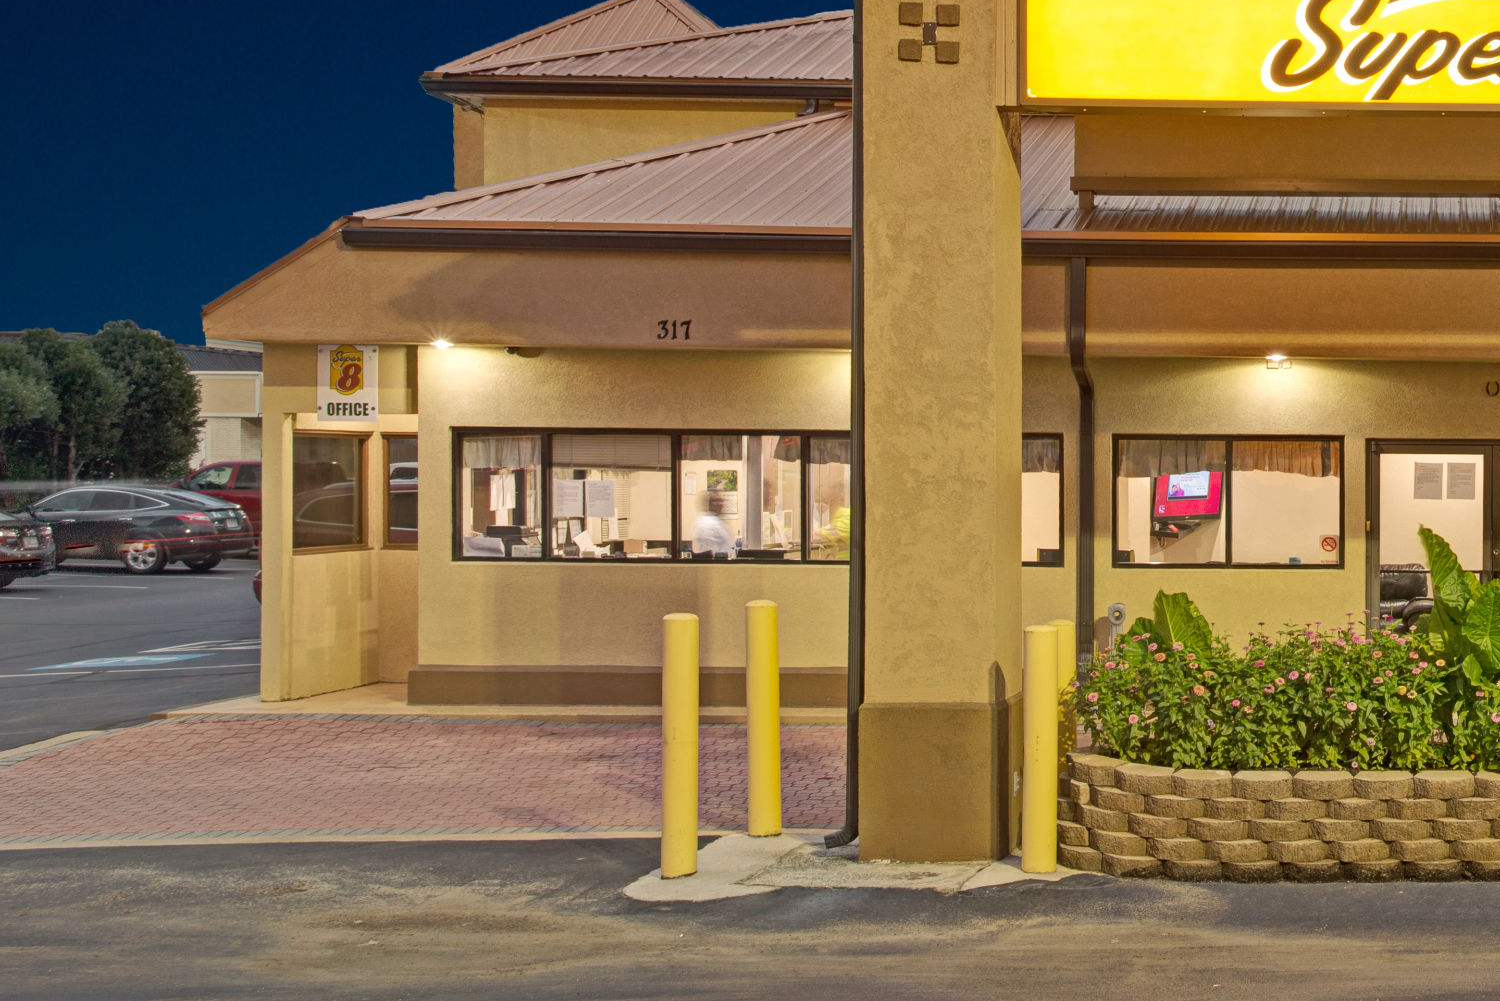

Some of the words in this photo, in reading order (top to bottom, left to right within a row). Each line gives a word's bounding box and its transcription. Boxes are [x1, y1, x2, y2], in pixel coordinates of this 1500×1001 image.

[657, 319, 692, 340] 317
[332, 350, 361, 368] Super
[336, 363, 362, 391] 8
[327, 402, 369, 416] OFFICE
